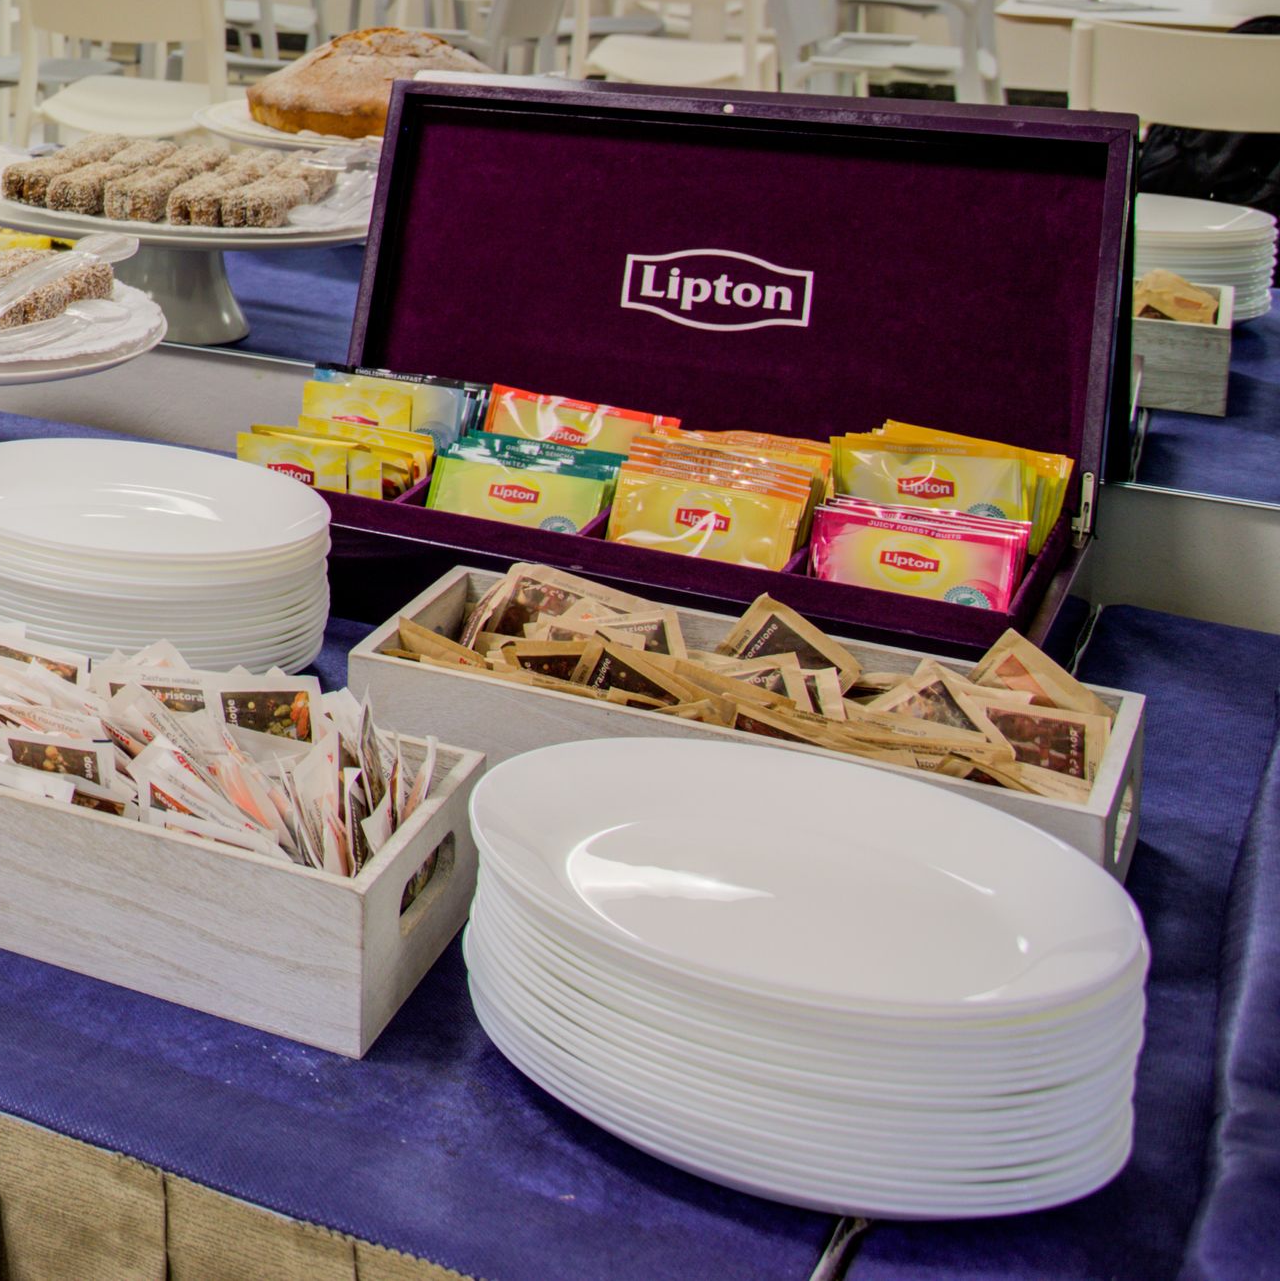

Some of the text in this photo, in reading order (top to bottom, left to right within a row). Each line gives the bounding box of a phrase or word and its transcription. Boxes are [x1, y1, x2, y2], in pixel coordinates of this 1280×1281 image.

[640, 264, 793, 311] Lipton
[385, 372, 422, 383] REAKFAST
[493, 485, 535, 501] Lipton
[903, 480, 950, 495] Lipton
[680, 510, 726, 529] Lipn
[868, 519, 962, 540] JUICY FOREST FRUITS
[884, 552, 935, 570] Lipton
